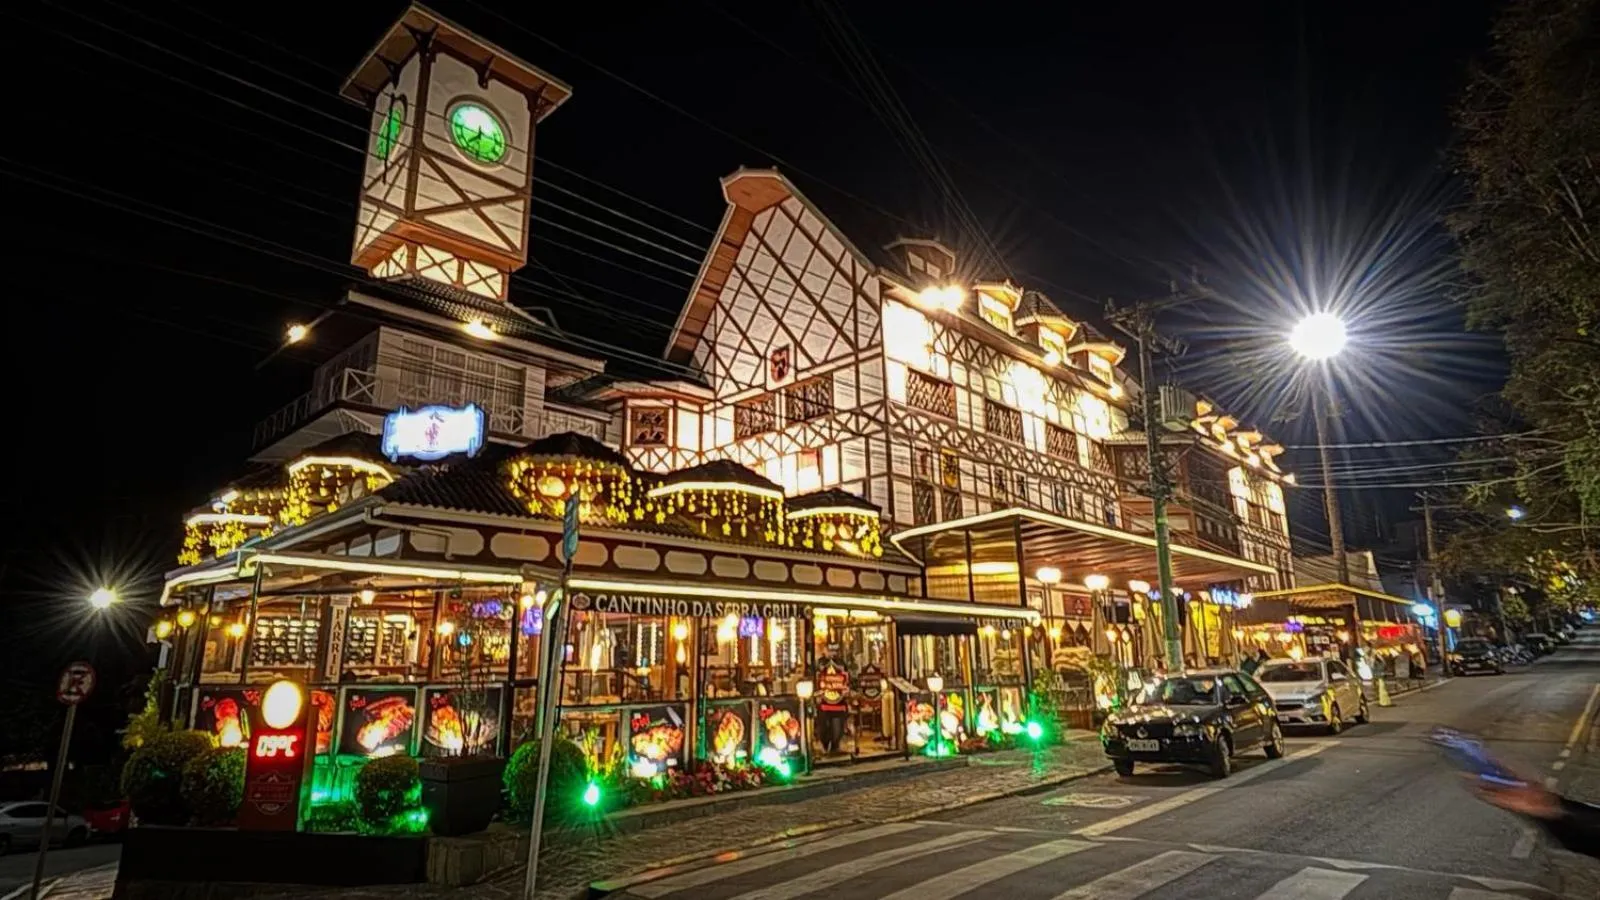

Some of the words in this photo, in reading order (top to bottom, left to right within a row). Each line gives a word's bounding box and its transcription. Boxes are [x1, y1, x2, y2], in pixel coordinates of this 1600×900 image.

[595, 594, 688, 616] CANTINHO
[692, 600, 713, 617] DA
[714, 601, 760, 617] SERRA
[763, 603, 801, 618] GRILL
